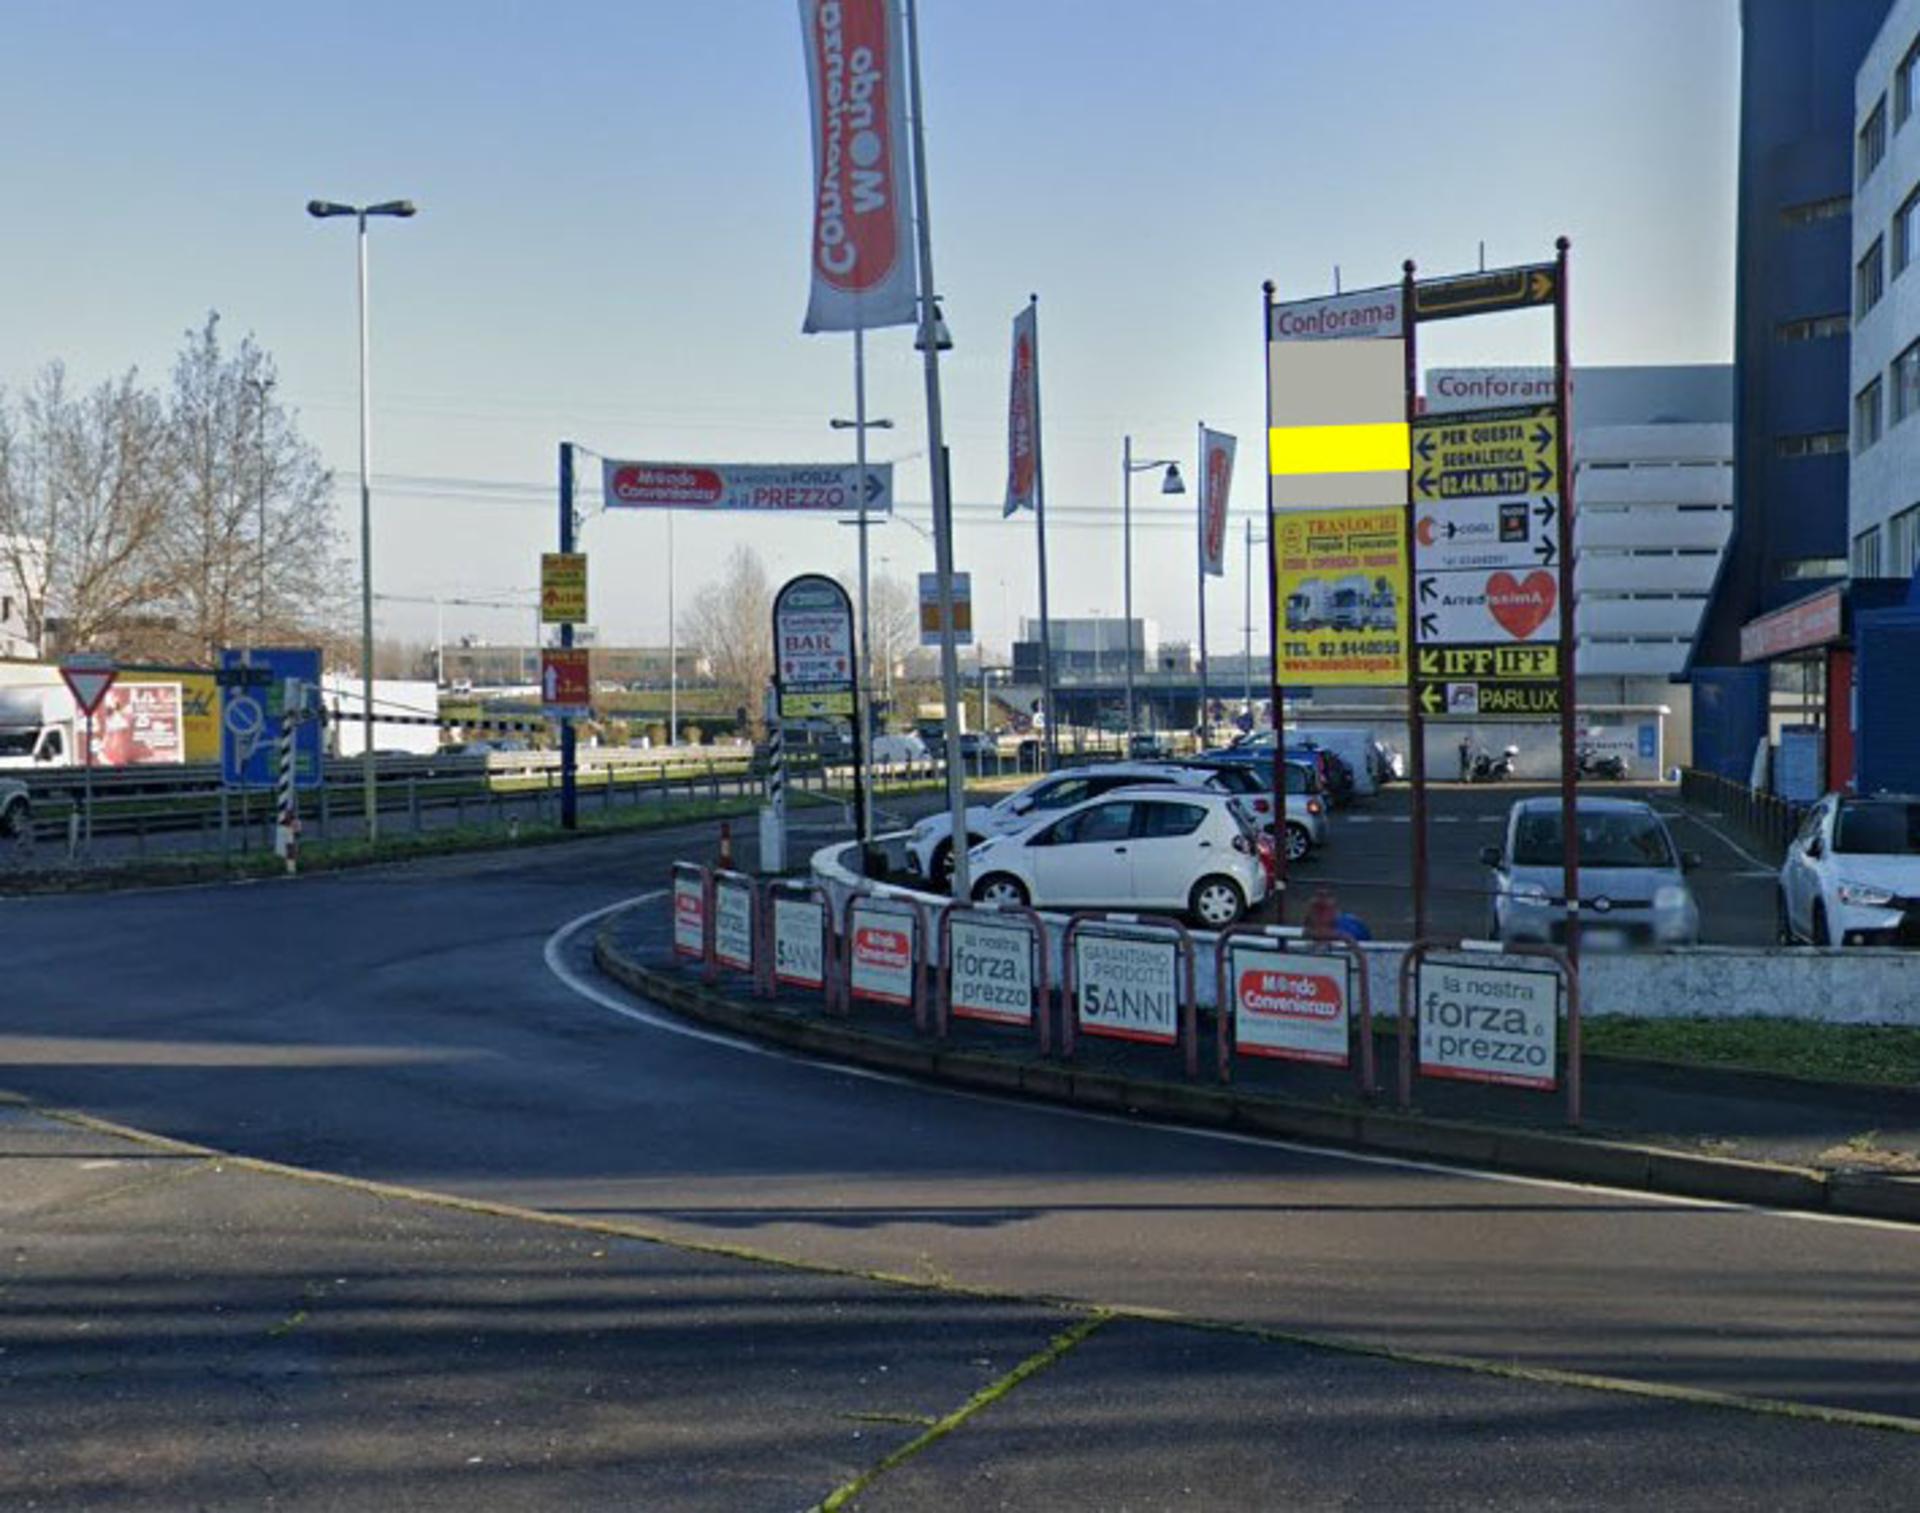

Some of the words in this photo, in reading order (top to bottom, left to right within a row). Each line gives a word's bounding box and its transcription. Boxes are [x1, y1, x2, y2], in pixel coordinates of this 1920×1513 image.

[1278, 303, 1396, 336] Conforama
[1441, 429, 1467, 445] PER
[1472, 426, 1525, 445] QUESTA
[791, 471, 843, 484] FORZA
[754, 487, 845, 508] PREZZO
[785, 635, 832, 651] BAR
[1480, 687, 1559, 711] PARLUX
[955, 946, 1017, 982] forza
[963, 982, 1028, 1006] prezzo
[1261, 975, 1318, 997] Mondo
[1443, 976, 1461, 993] la
[1466, 979, 1534, 1000] nostra
[1244, 990, 1336, 1015] Convenienza
[1425, 992, 1529, 1036] forza
[1438, 1034, 1547, 1067] prezzo
